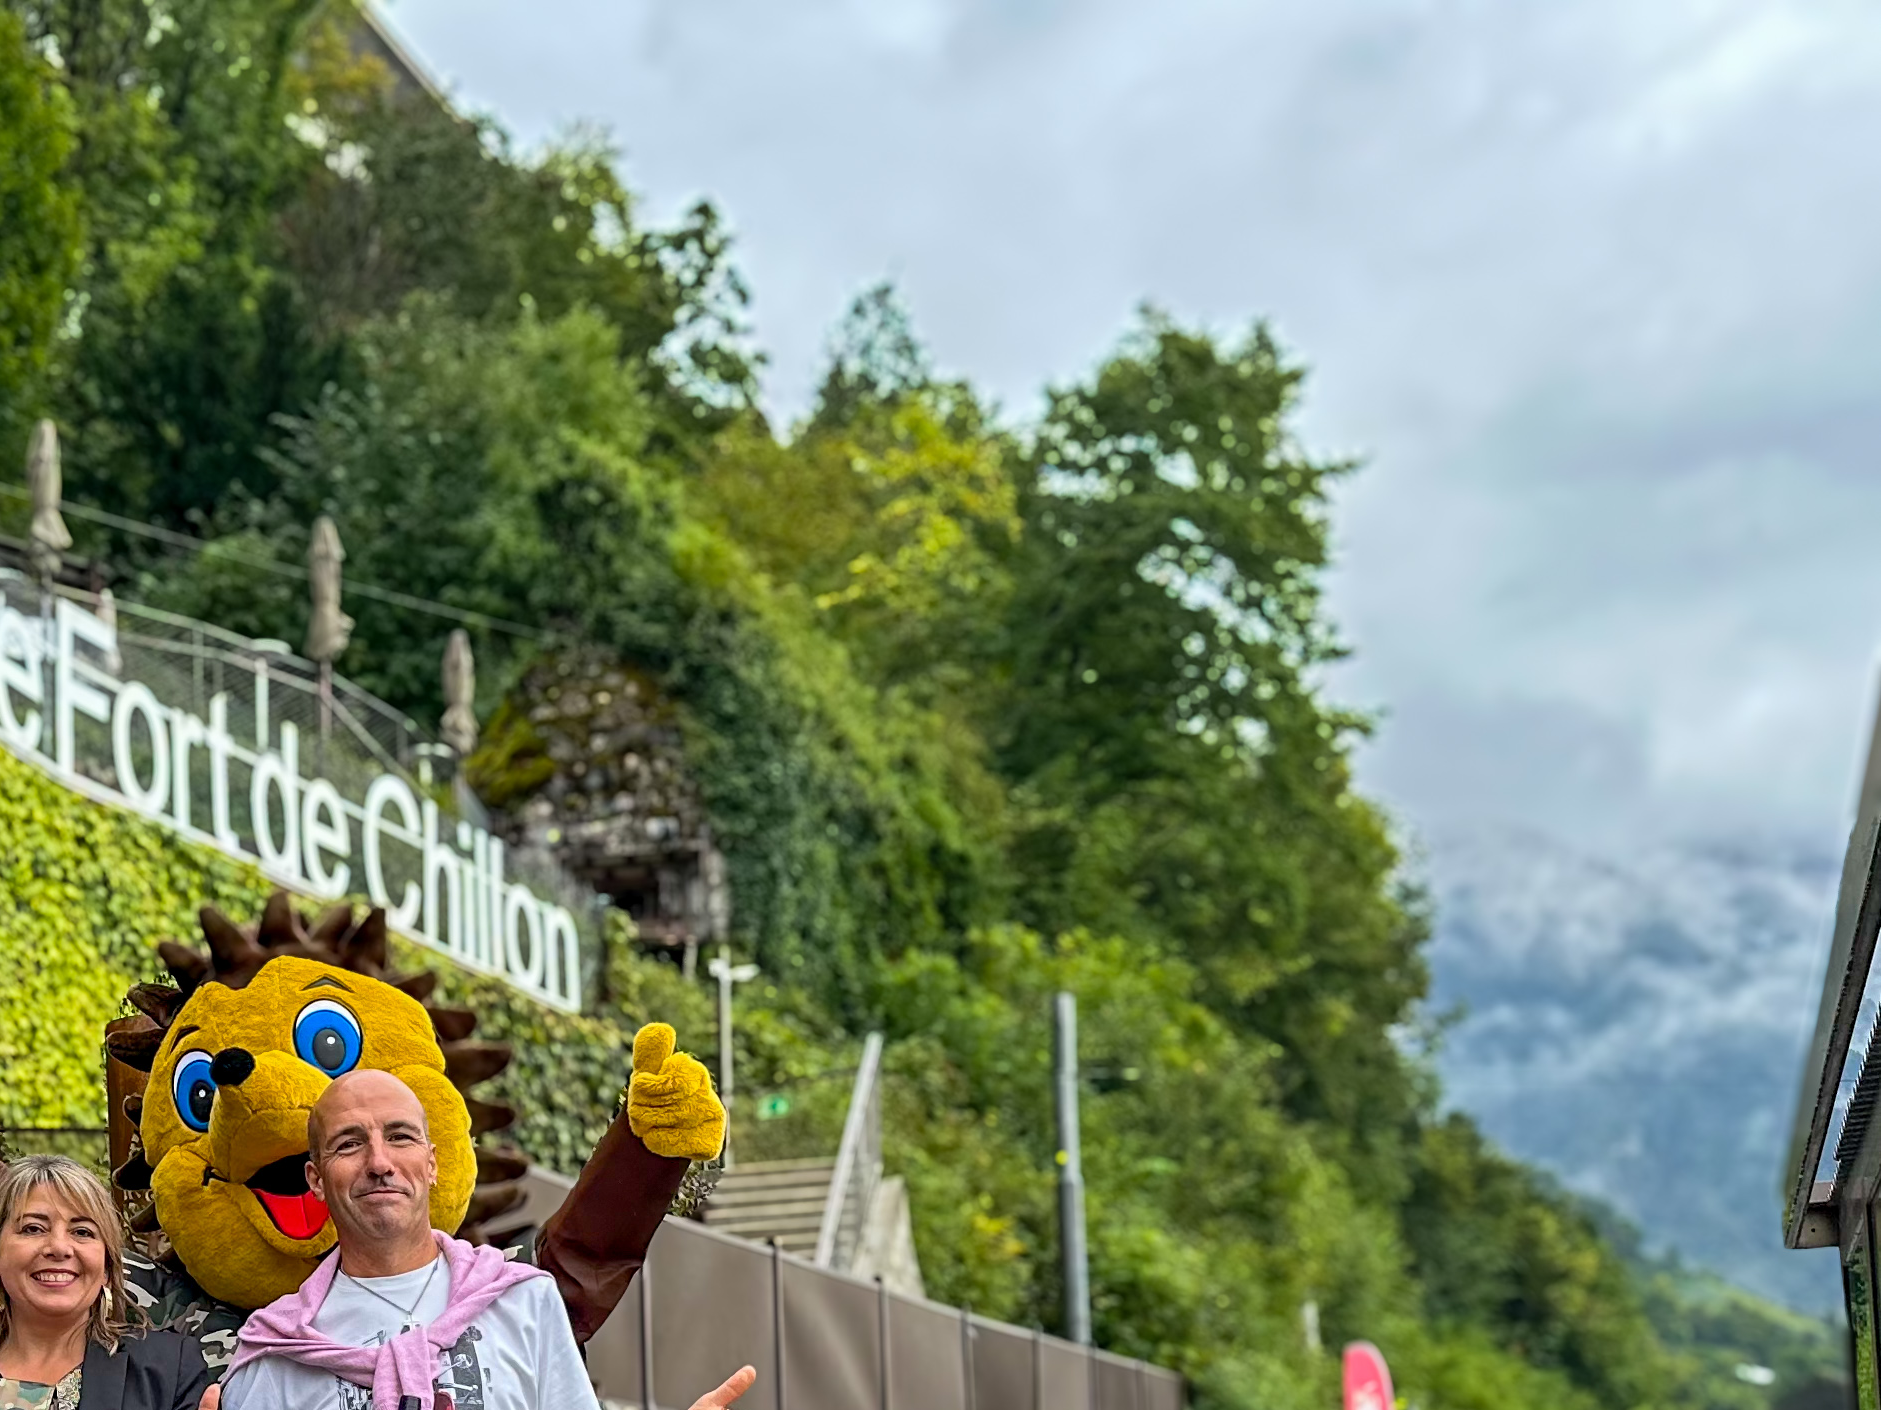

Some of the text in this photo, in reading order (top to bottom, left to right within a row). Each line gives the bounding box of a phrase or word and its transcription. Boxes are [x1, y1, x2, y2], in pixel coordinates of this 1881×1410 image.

[55, 598, 240, 852] Fort
[249, 719, 355, 902] de
[363, 772, 583, 1016] Chillon
